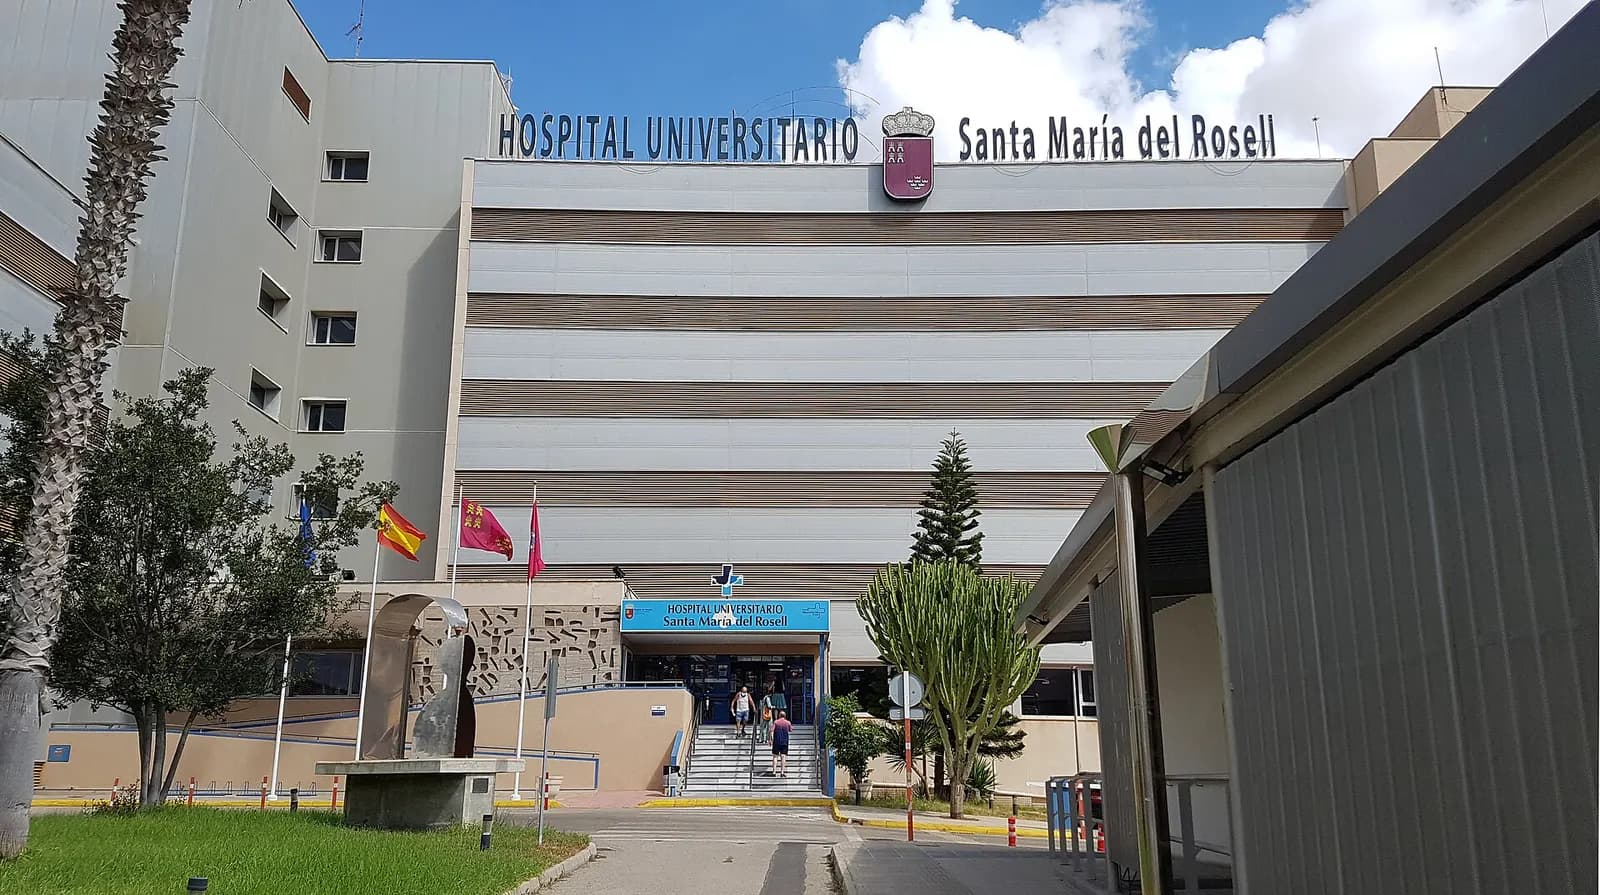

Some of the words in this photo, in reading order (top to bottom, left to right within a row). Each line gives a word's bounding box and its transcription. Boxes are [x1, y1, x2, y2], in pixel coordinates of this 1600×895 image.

[499, 113, 634, 159] HOSPITAL
[647, 116, 859, 162] UNIVERSITARIO
[958, 116, 1036, 161] Santa
[1048, 114, 1124, 160] María
[1138, 115, 1180, 158] del
[1192, 114, 1276, 158] Rosell
[667, 604, 711, 614] HOSPITAL
[714, 604, 783, 614] UNIVERSITARIO
[663, 616, 695, 627] Santa
[735, 615, 753, 626] del
[755, 615, 788, 627] Rosell
